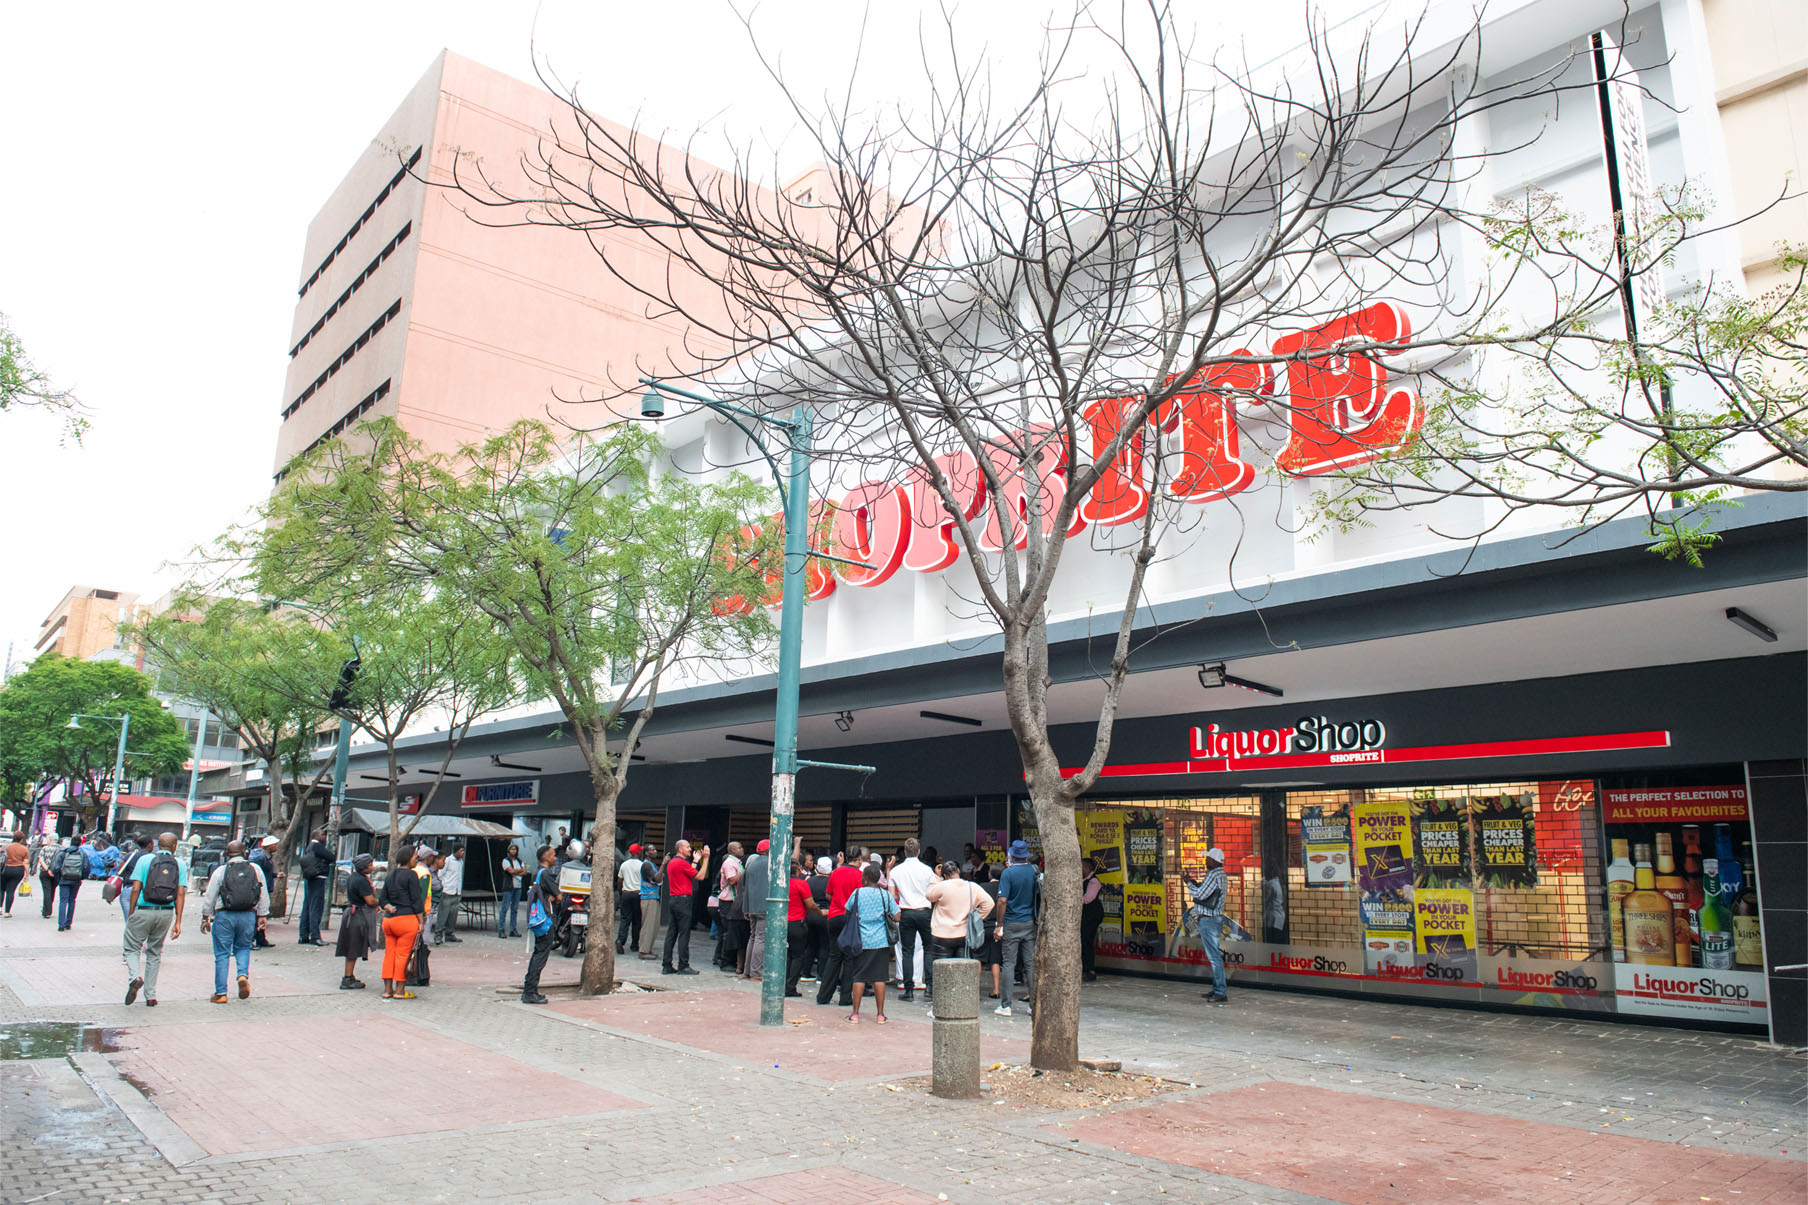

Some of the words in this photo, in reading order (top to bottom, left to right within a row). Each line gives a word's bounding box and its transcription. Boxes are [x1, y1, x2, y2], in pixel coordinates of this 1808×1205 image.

[1190, 716, 1386, 765] LiquorShop
[1330, 752, 1379, 763] SHOPRITE
[478, 782, 534, 801] FURNITURE
[1610, 794, 1628, 802] THE
[1630, 792, 1671, 802] PERFECT
[1674, 790, 1728, 800] SELECTION
[1731, 789, 1745, 799] TO
[1612, 808, 1631, 818] ALL
[1635, 807, 1668, 817] YOUR
[1671, 805, 1746, 817] FAVOURITES
[1303, 818, 1323, 827] WIN
[1359, 816, 1406, 827] POWER
[1483, 820, 1499, 828] FRUIT
[1509, 820, 1521, 828] VEG
[1364, 832, 1402, 841] POCKET
[1421, 831, 1459, 840] PRICES
[1483, 829, 1524, 838] PRICES
[1132, 855, 1156, 864] YEAR
[1424, 853, 1460, 864] YEAR
[1485, 853, 1525, 863] YEAR
[1127, 895, 1162, 905] POWER
[1362, 903, 1383, 911] WIN
[1385, 904, 1412, 912] R500
[1418, 903, 1469, 915] POWER
[1130, 909, 1158, 917] POCKET
[1424, 920, 1465, 930] POCKET
[1705, 942, 1728, 950] LITE
[1271, 952, 1347, 973] LiquorShop
[1377, 960, 1464, 980] LiquorShop
[1497, 967, 1598, 991] LiquorShop
[1633, 973, 1749, 1000] LiquorShop
